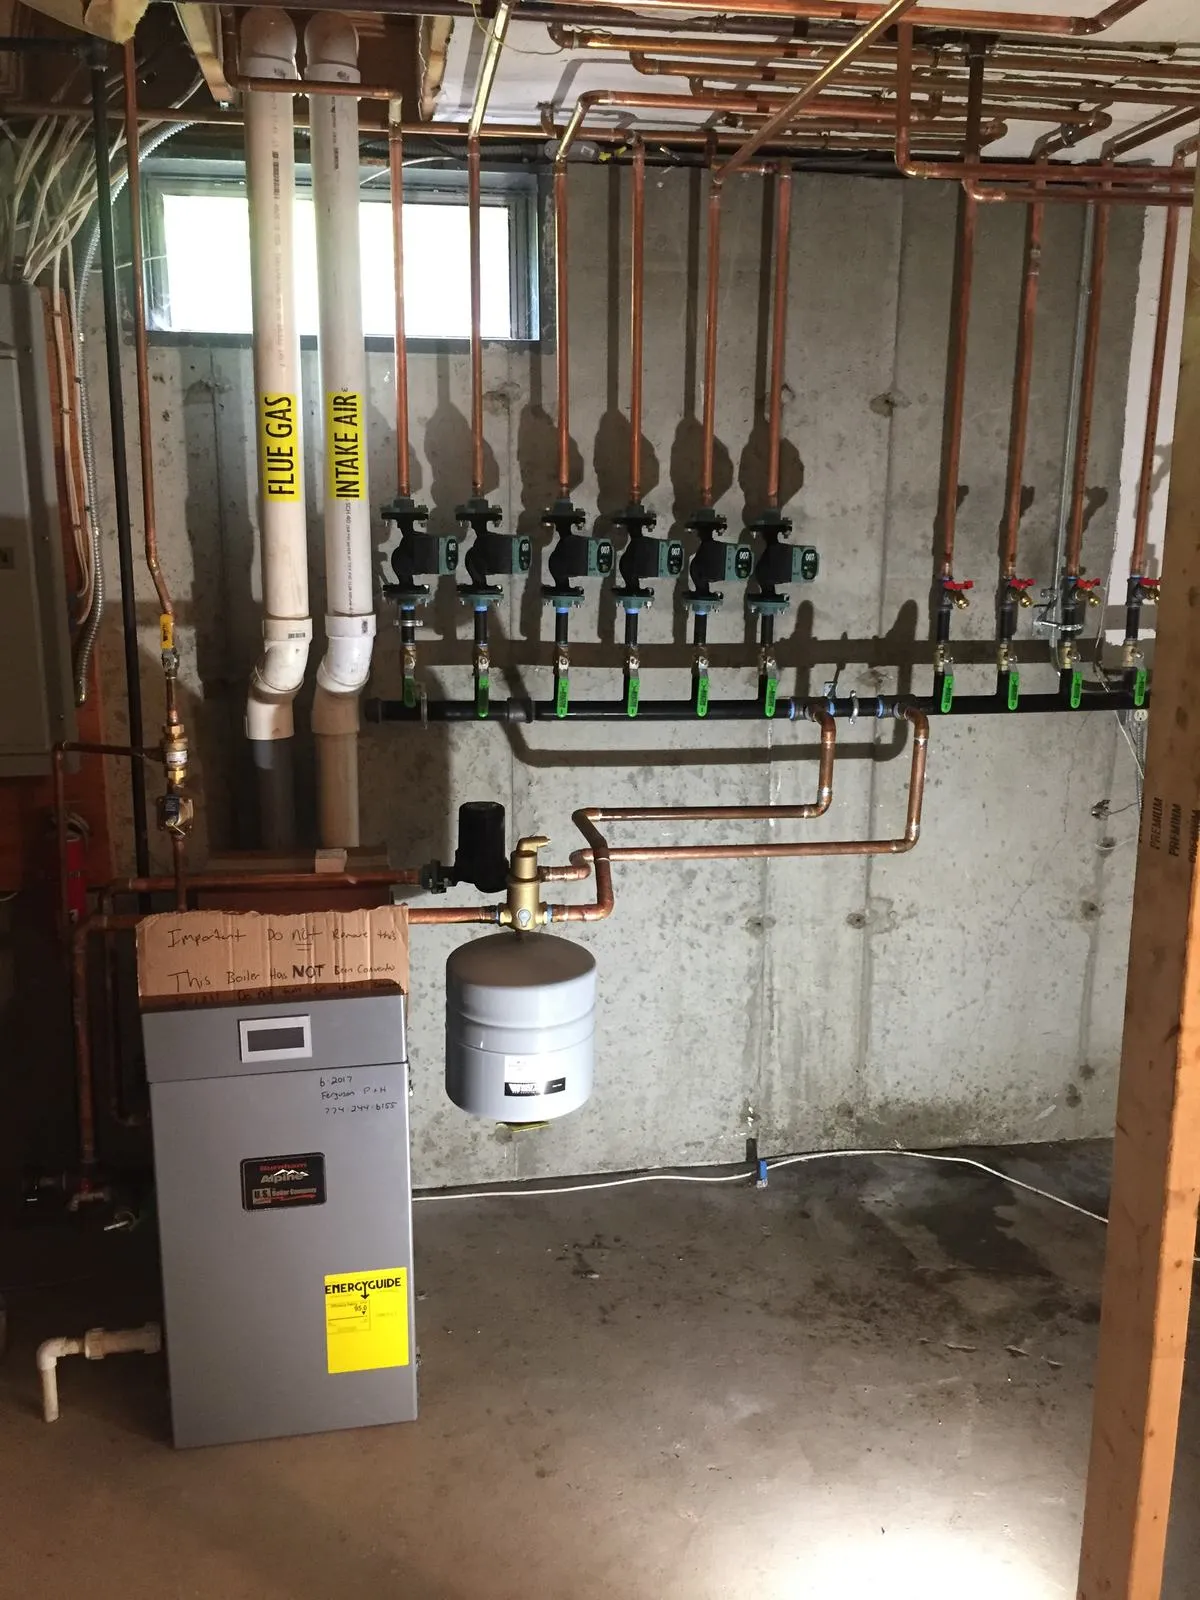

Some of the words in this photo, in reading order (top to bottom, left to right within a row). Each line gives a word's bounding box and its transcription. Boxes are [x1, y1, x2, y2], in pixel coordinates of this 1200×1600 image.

[264, 396, 293, 439] GAS
[332, 394, 358, 427] AIR
[266, 446, 295, 495] FLUE
[334, 432, 360, 499] INTAKE
[600, 546, 610, 554] 007
[671, 547, 680, 556] 007
[739, 551, 749, 560] 007
[805, 553, 815, 561] 007
[1150, 797, 1163, 850] PREMIUM
[1168, 803, 1181, 857] PREMIUM
[168, 928, 247, 948] Important
[168, 969, 211, 992] This
[226, 969, 260, 984] Boiler
[270, 967, 288, 981] Has
[292, 964, 326, 979] NOT
[321, 1091, 355, 1100] Ferguson
[261, 1173, 304, 1184] Alpine
[325, 1277, 401, 1297] ENERGYGUIDE
